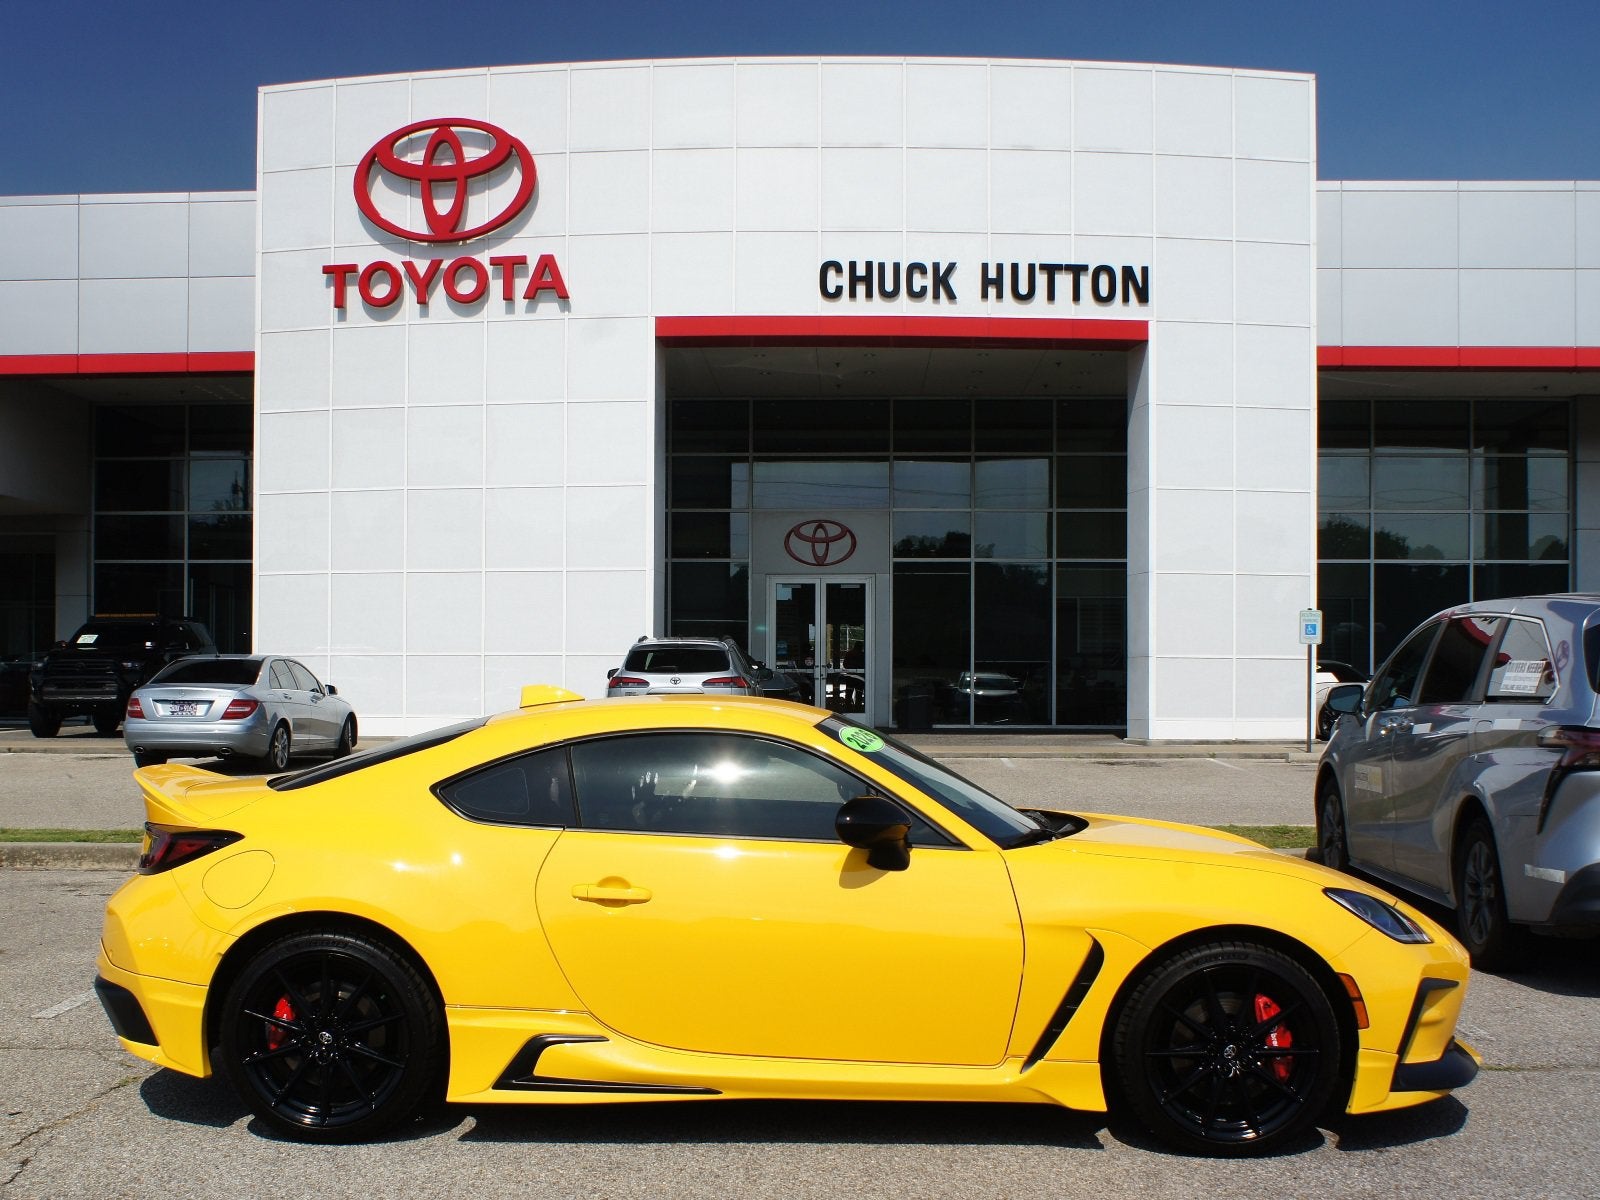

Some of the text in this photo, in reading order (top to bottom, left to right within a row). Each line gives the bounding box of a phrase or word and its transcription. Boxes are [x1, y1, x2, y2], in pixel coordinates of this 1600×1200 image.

[322, 254, 570, 308] TOYOTA
[819, 260, 1149, 303] CHUCK HUTTON
